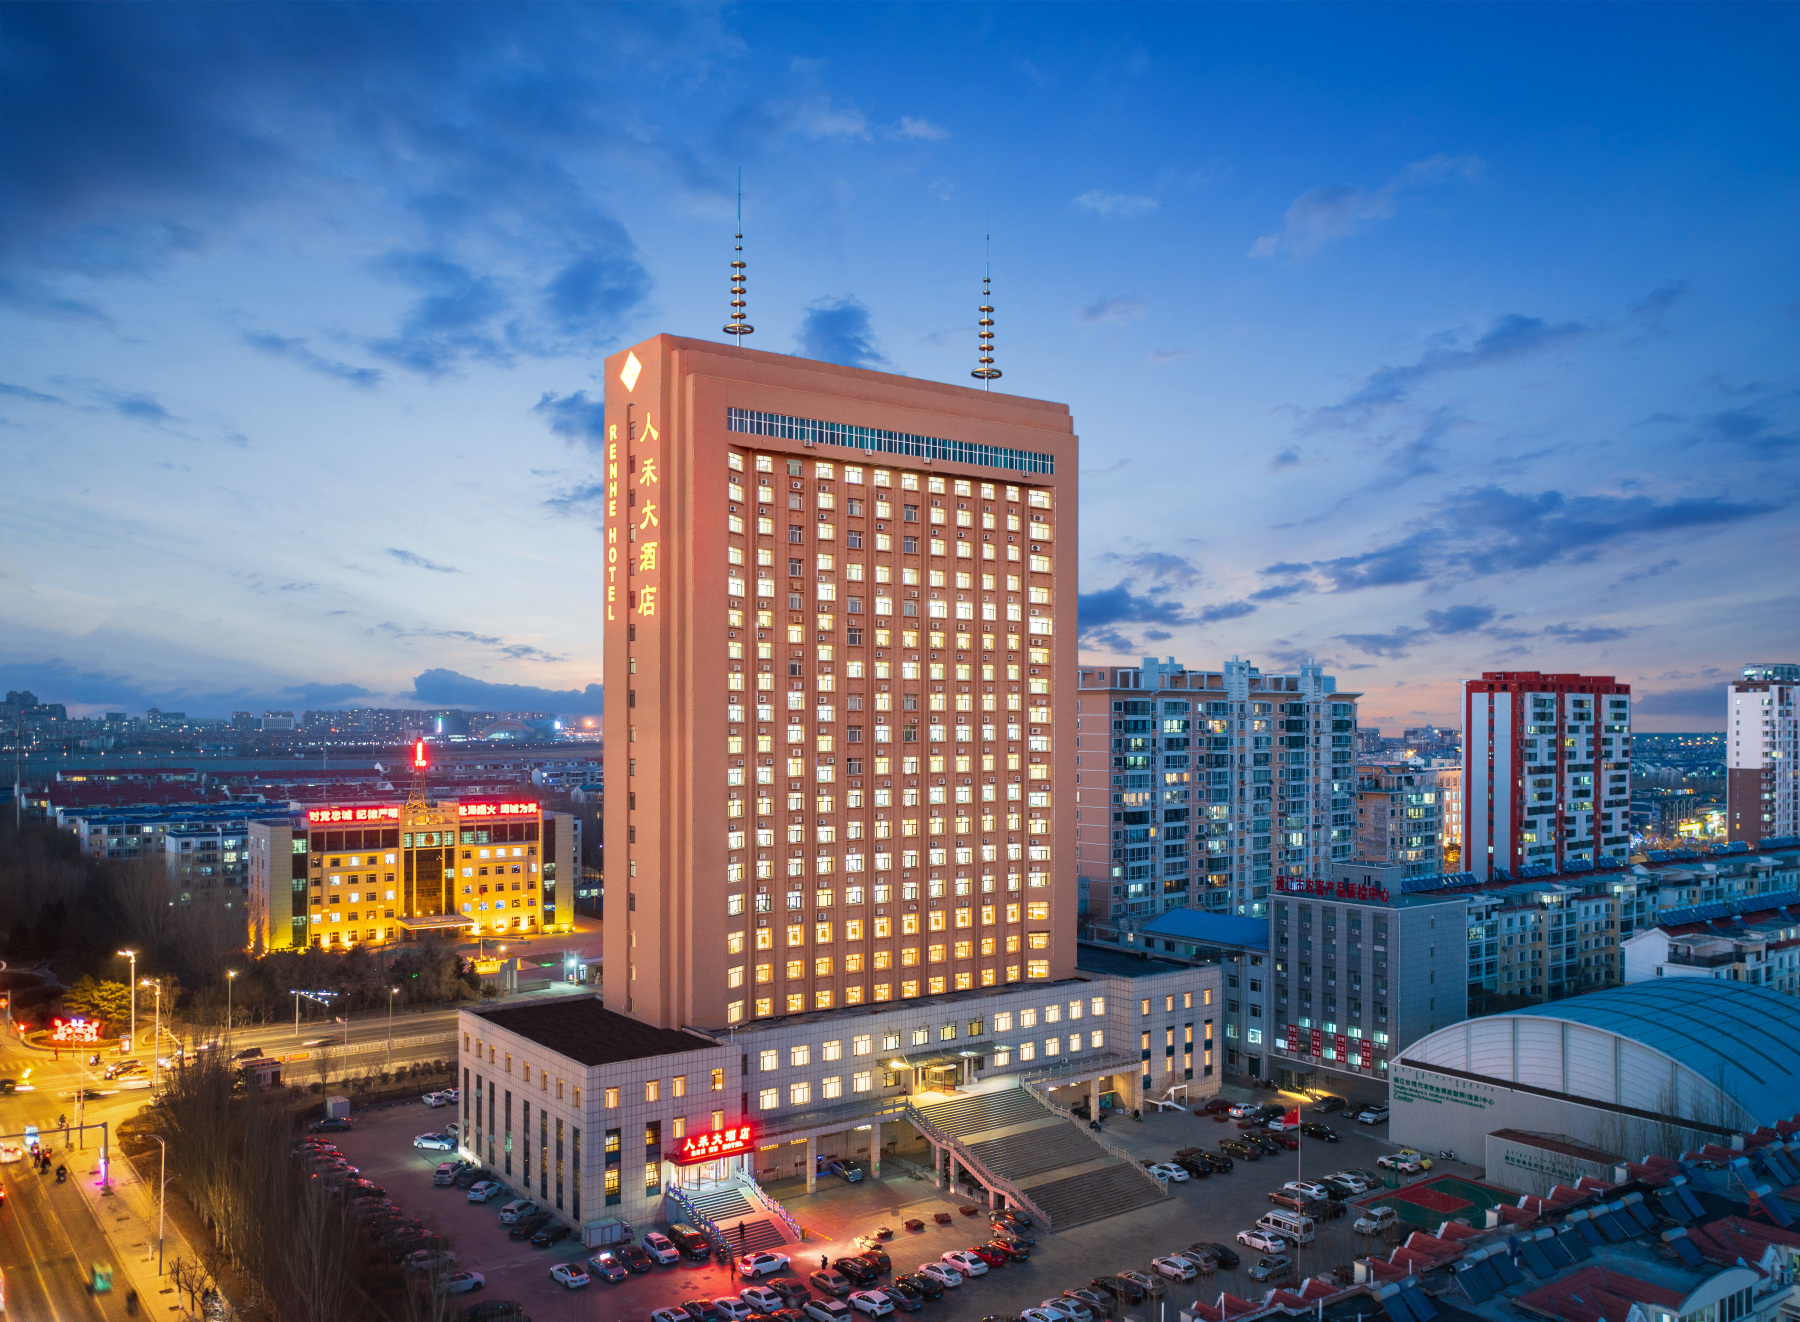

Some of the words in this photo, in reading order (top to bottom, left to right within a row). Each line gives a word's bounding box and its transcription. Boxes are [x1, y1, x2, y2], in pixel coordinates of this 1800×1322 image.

[608, 424, 618, 517] RENHE
[638, 412, 659, 617] 人禾大酒店
[607, 527, 617, 621] HOTEL
[308, 809, 353, 822] 对党忠诚
[356, 807, 398, 820] 纪律严明
[1275, 875, 1390, 903] 通辽市农畜产品质检中心
[683, 1126, 750, 1151] 人禾大酒店
[722, 1140, 744, 1150] HOTEL
